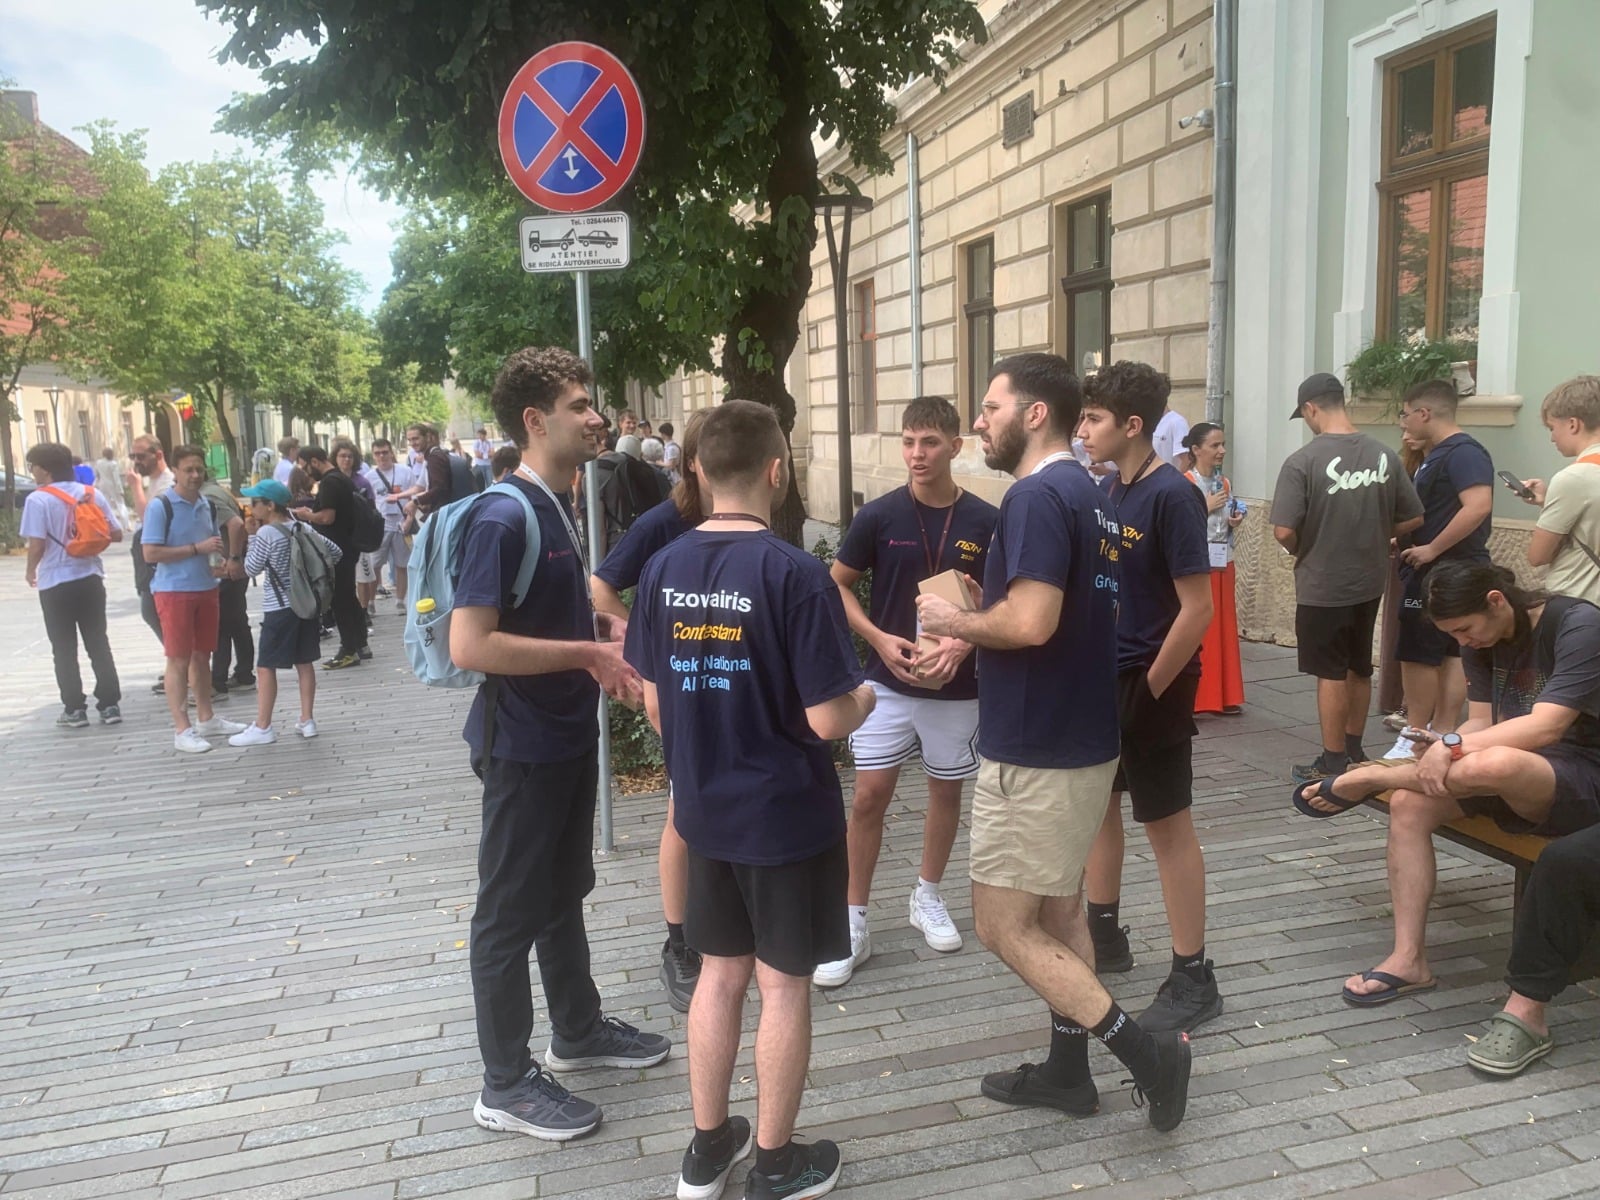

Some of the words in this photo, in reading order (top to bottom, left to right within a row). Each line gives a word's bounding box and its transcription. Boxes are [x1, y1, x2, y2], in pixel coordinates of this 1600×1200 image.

[563, 257, 622, 267] AUTOVEHICULUL
[1325, 452, 1390, 495] Seoul
[662, 588, 752, 613] Tzovairis
[673, 621, 743, 641] Contestant
[703, 654, 751, 672] National
[682, 676, 696, 691] AI
[701, 674, 730, 691] Team
[1054, 1022, 1086, 1035] VAN
